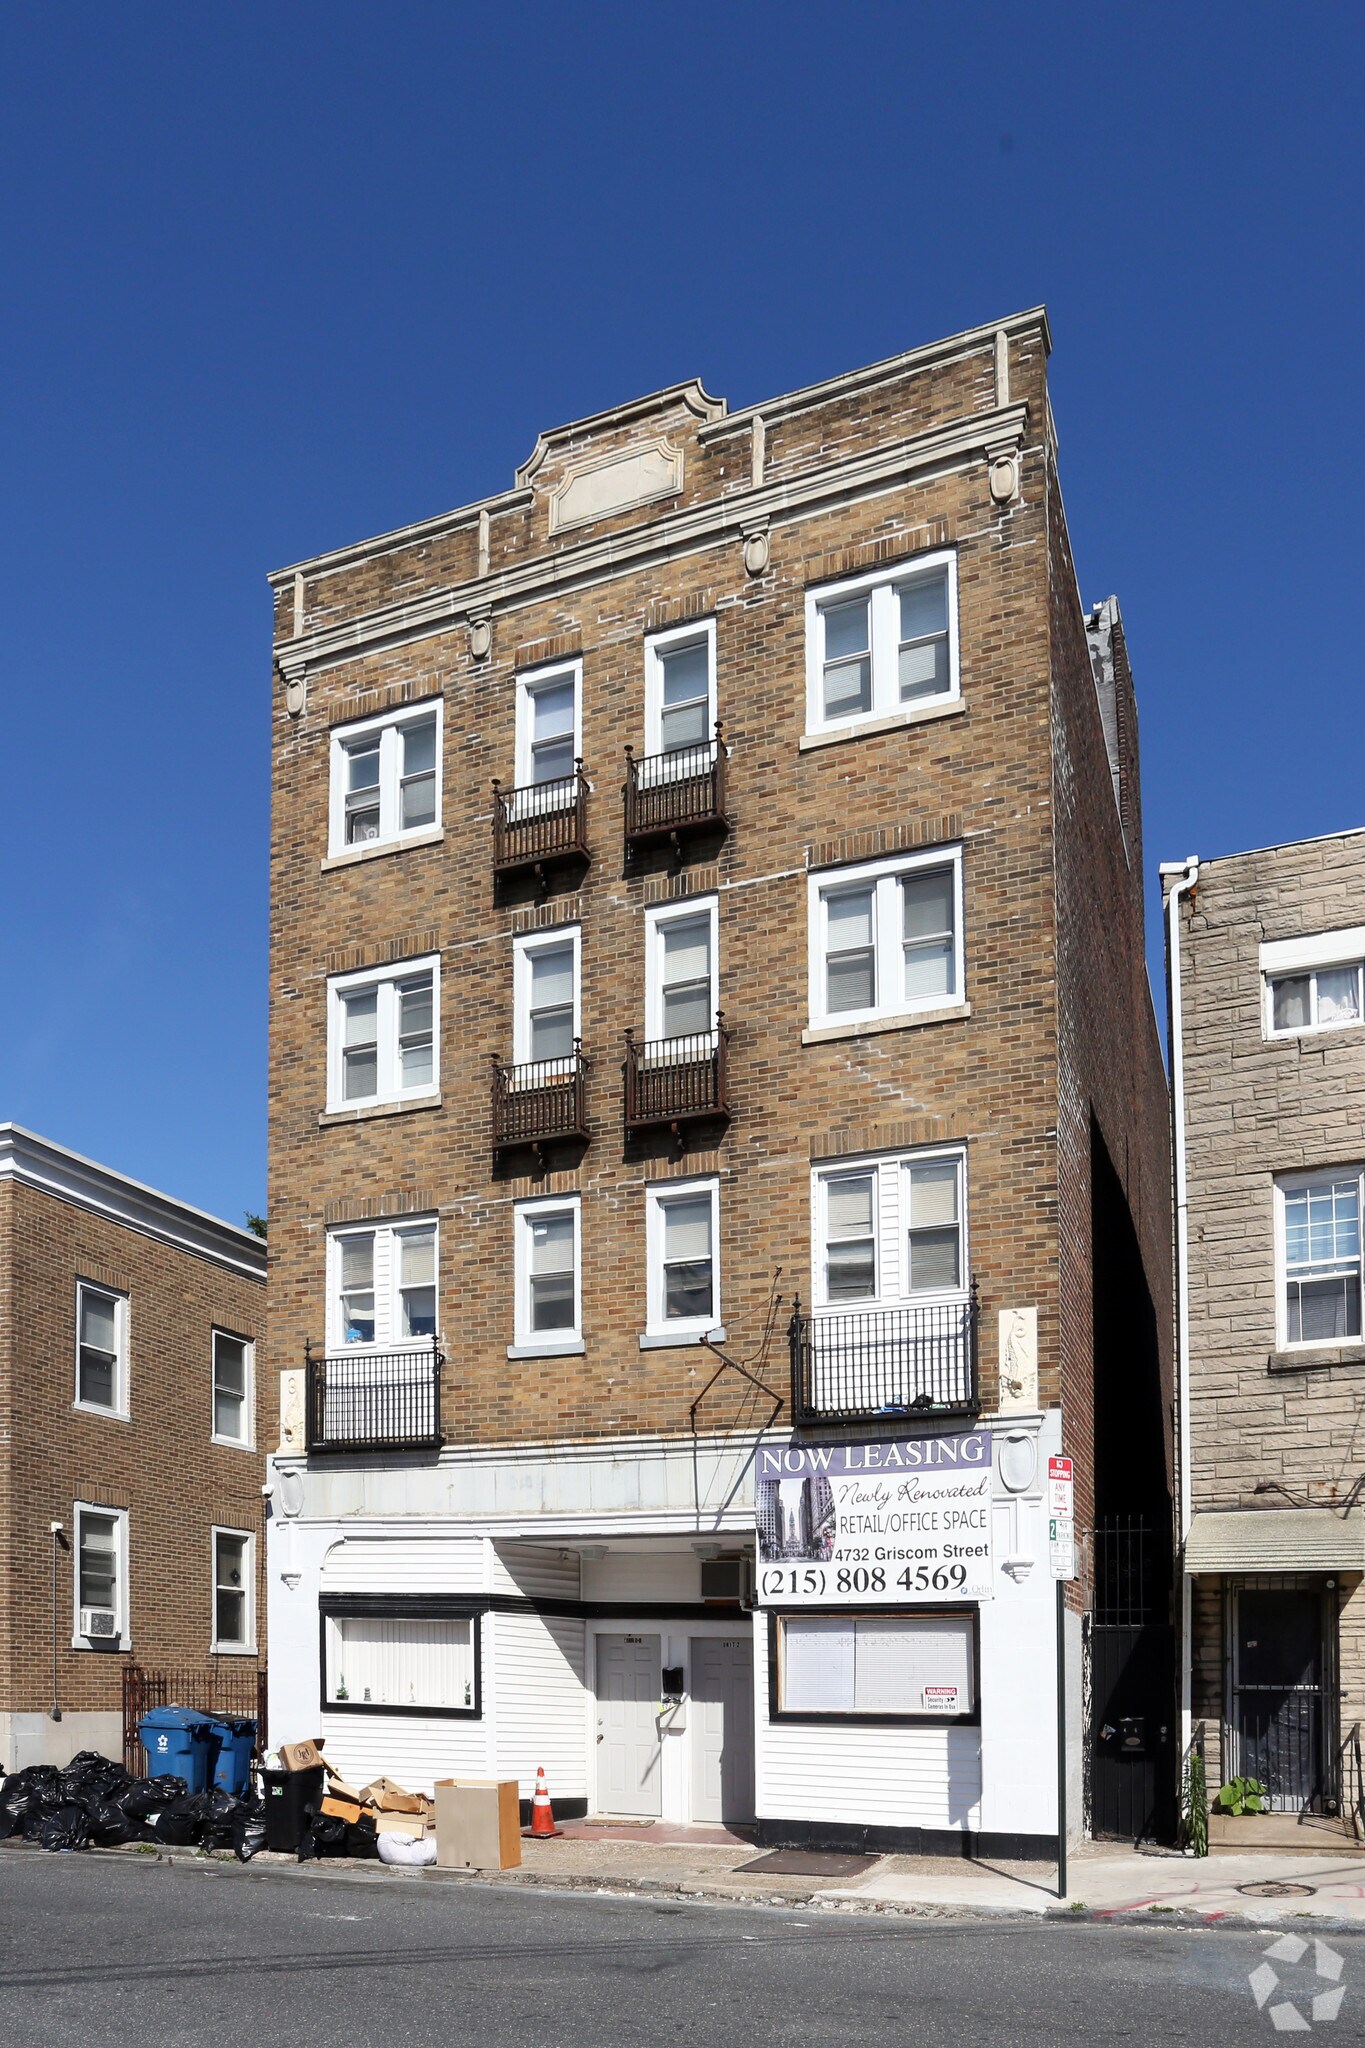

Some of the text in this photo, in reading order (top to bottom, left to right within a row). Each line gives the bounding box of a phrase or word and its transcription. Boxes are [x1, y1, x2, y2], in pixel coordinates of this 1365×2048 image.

[762, 1436, 985, 1474] NOW LEASING
[1056, 1460, 1064, 1469] NO
[1050, 1469, 1071, 1479] STOPPING
[839, 1476, 988, 1510] Newly Renovated
[1055, 1482, 1065, 1492] ANY
[840, 1509, 987, 1535] RETAIL/OFFICE SPACE
[1050, 1522, 1056, 1538] 2
[835, 1543, 989, 1562] 4732 Griscom Street
[762, 1564, 967, 1596] (215) 808 4569
